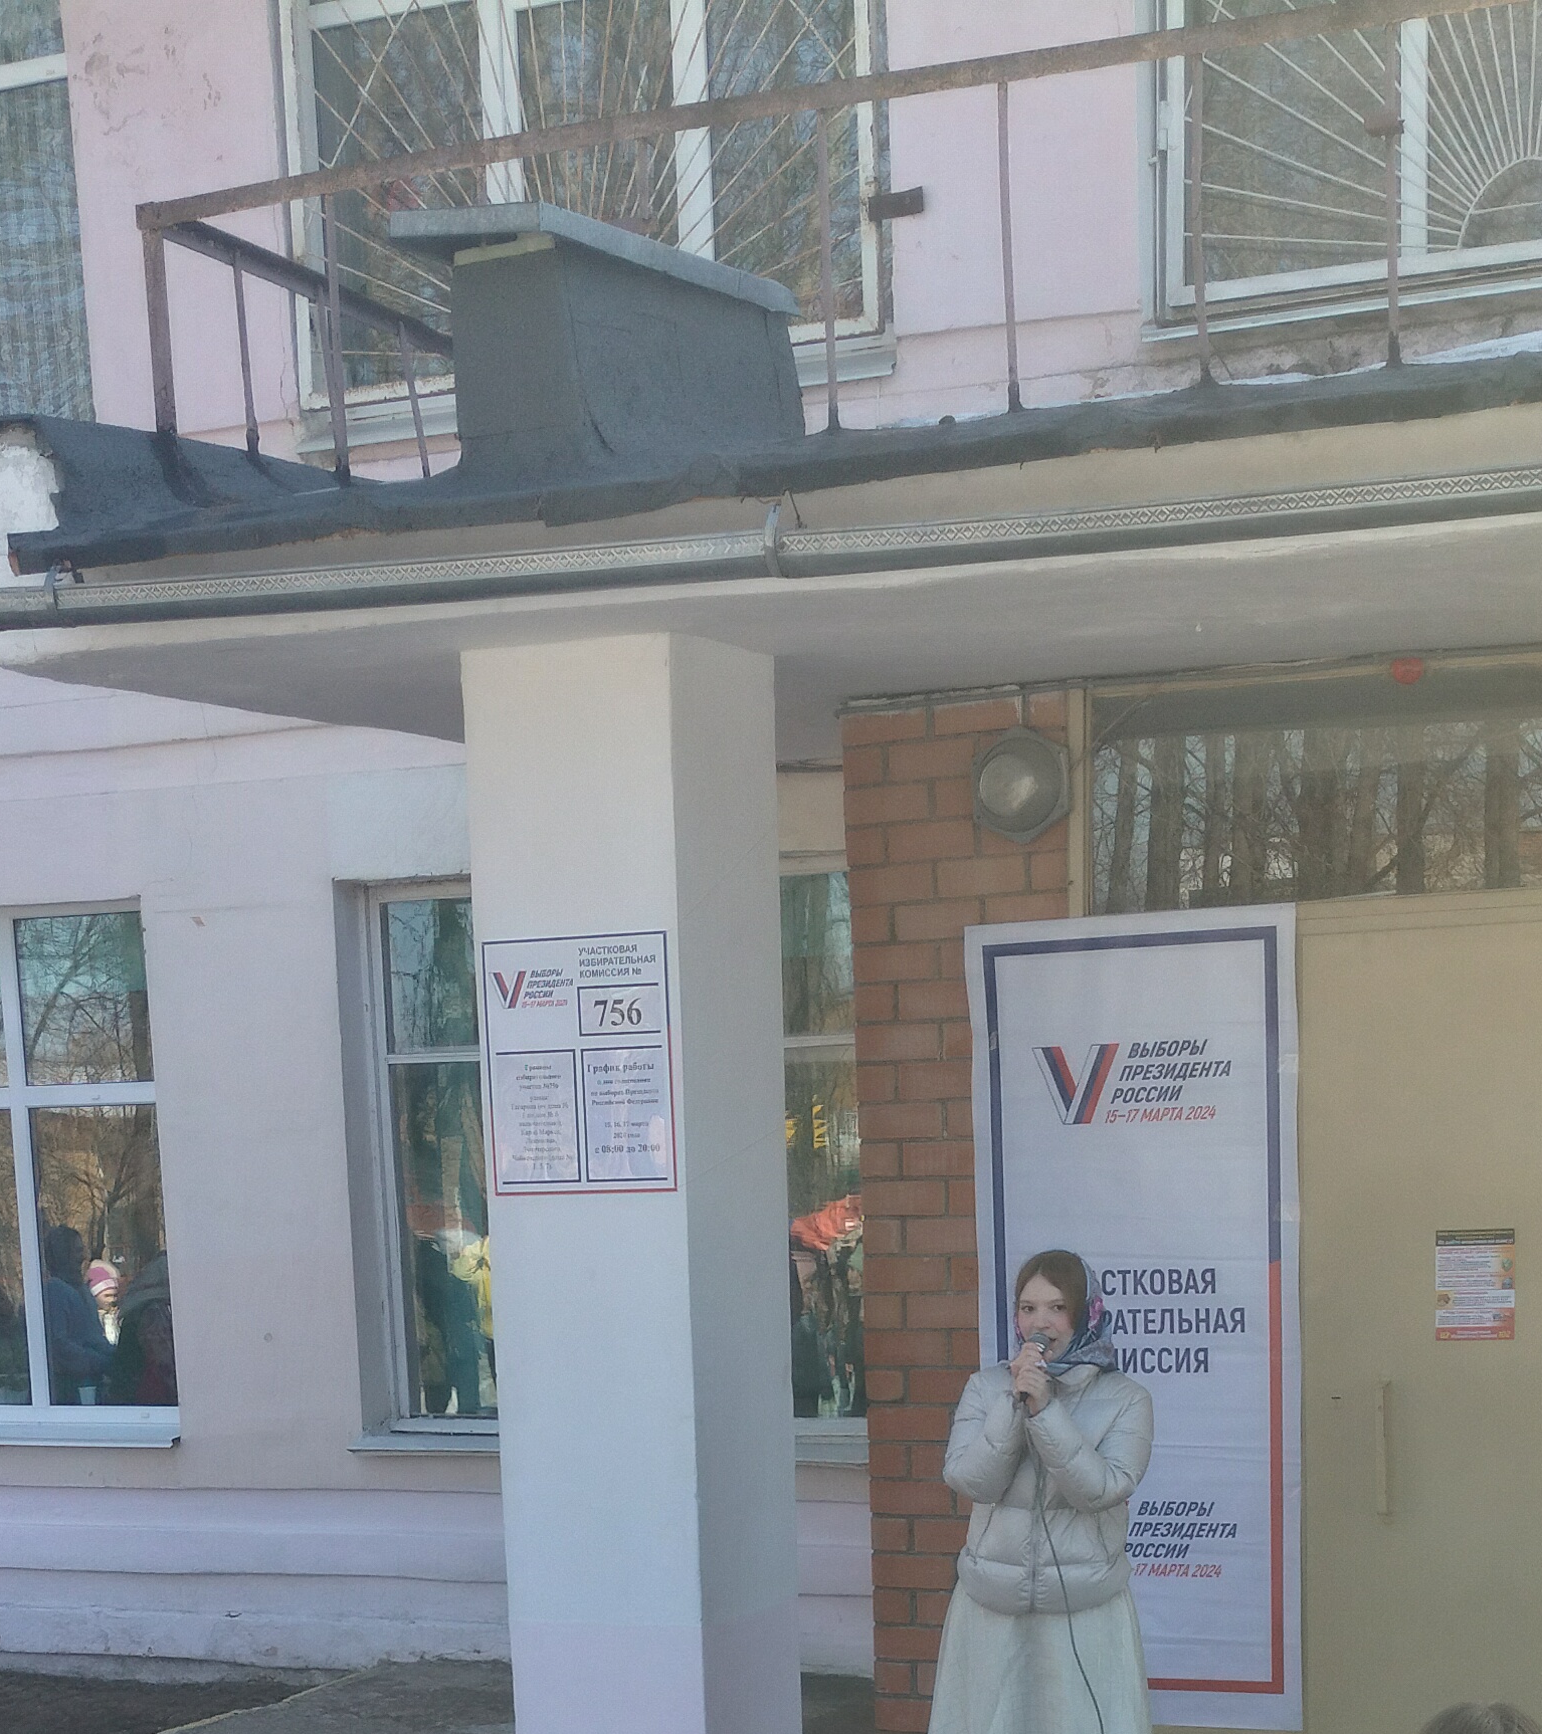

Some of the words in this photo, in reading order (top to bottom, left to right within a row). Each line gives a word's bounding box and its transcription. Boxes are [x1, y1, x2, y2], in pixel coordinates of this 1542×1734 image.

[578, 944, 637, 956] УЧАСТКОВАЯ
[579, 954, 656, 967] ИЗБИРАТЕЛЬНАЯ
[530, 968, 563, 978] ВЫБОРЫ
[579, 967, 629, 978] КОМИССИЯ
[526, 978, 574, 989] ПРЕЗИДЕНТА
[523, 990, 554, 999] РОССИИ
[593, 997, 642, 1027] 756
[1127, 1038, 1208, 1059] ВЫБОРЫ
[587, 1063, 620, 1075] График
[623, 1062, 655, 1073] работы
[1119, 1060, 1232, 1082] ПРЕЗИДЕНТА
[1110, 1085, 1183, 1104] РОССИИ
[1139, 1106, 1182, 1123] МАРТА
[1185, 1105, 1217, 1120] 2024
[1101, 1268, 1216, 1296] СТКОВАЯ
[1105, 1307, 1246, 1335] АТЕЛЬНАЯ
[1115, 1347, 1209, 1374] ИССИЯ
[1137, 1501, 1215, 1517] ВЫБОРЫ
[1128, 1522, 1238, 1540] ПРЕЗИДЕНТА
[1124, 1542, 1190, 1559] РОССИИ
[1148, 1563, 1190, 1577] МАРТА
[1191, 1564, 1223, 1578] 2024
